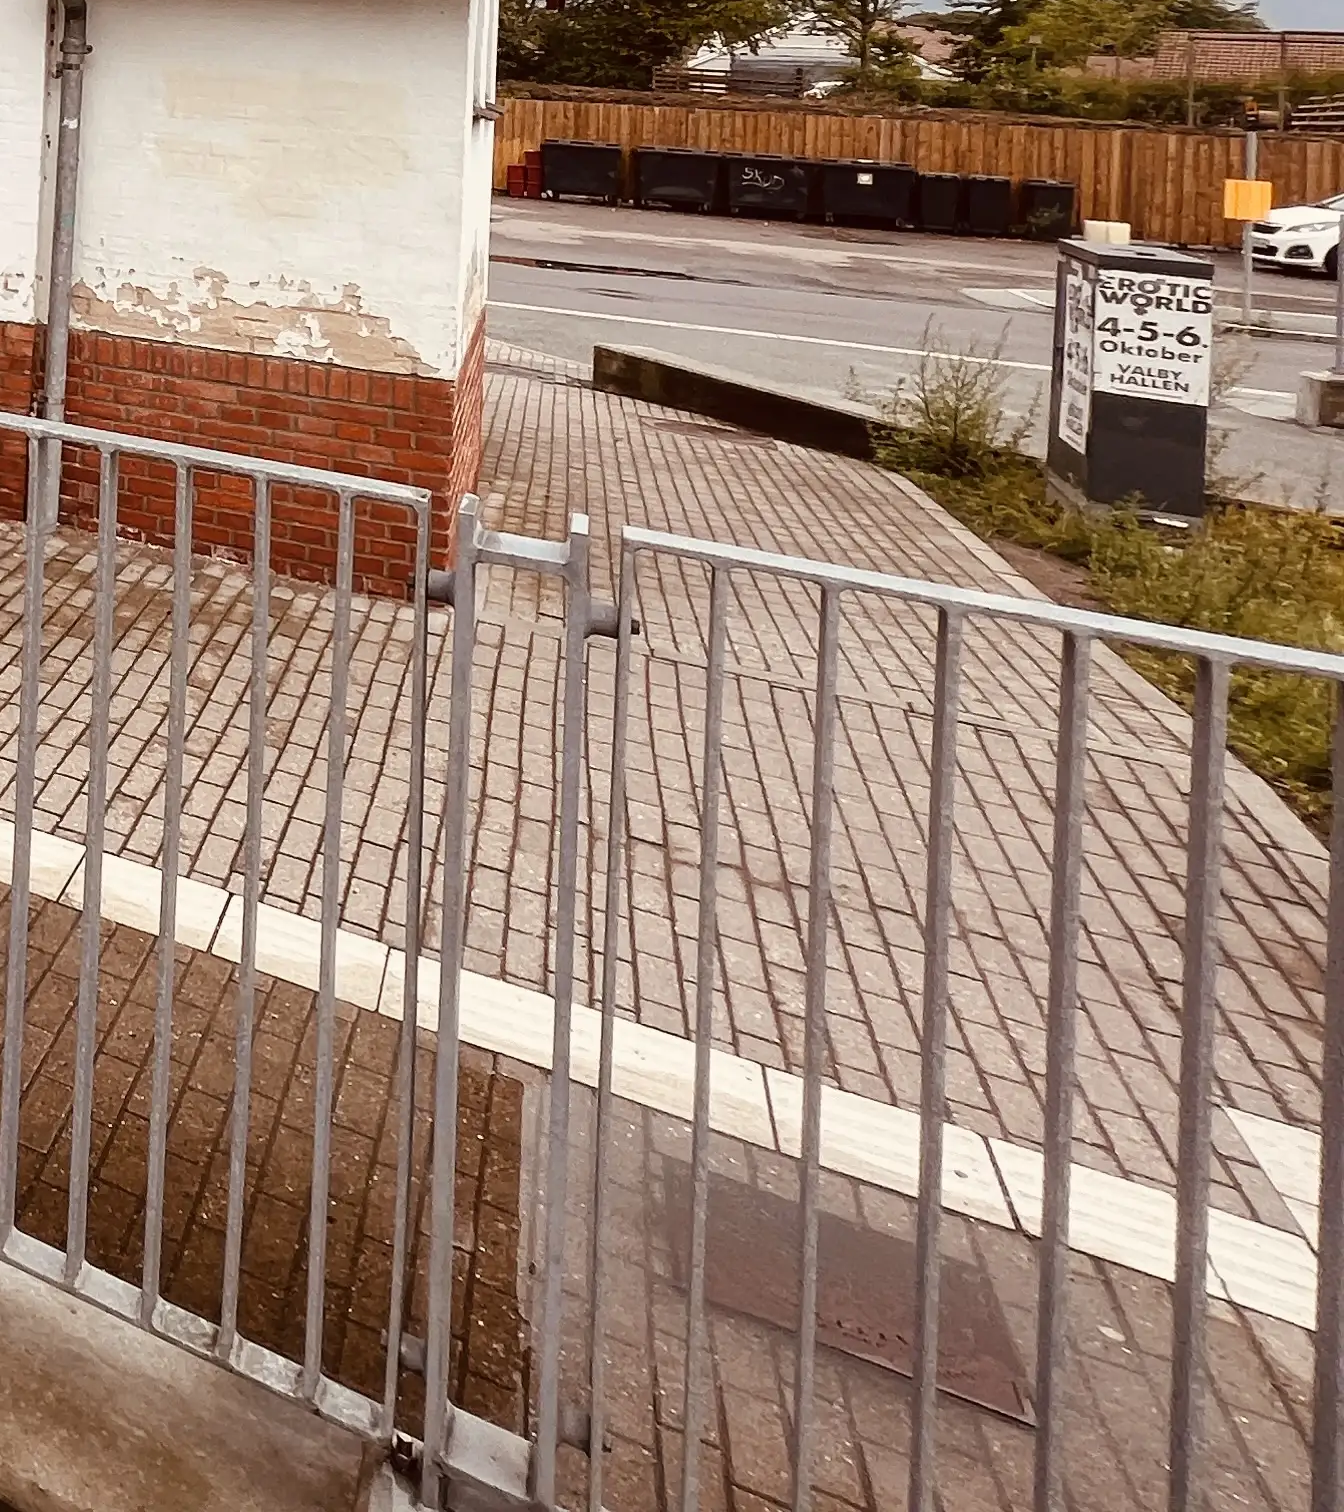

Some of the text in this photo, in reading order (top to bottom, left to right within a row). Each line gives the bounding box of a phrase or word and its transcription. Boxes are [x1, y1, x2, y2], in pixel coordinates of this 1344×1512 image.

[1098, 275, 1212, 301] EROTIC
[1098, 289, 1212, 316] WORLD
[1099, 339, 1204, 364] Oktober
[1109, 372, 1191, 393] HALLEN
[1117, 362, 1183, 381] VALBY
